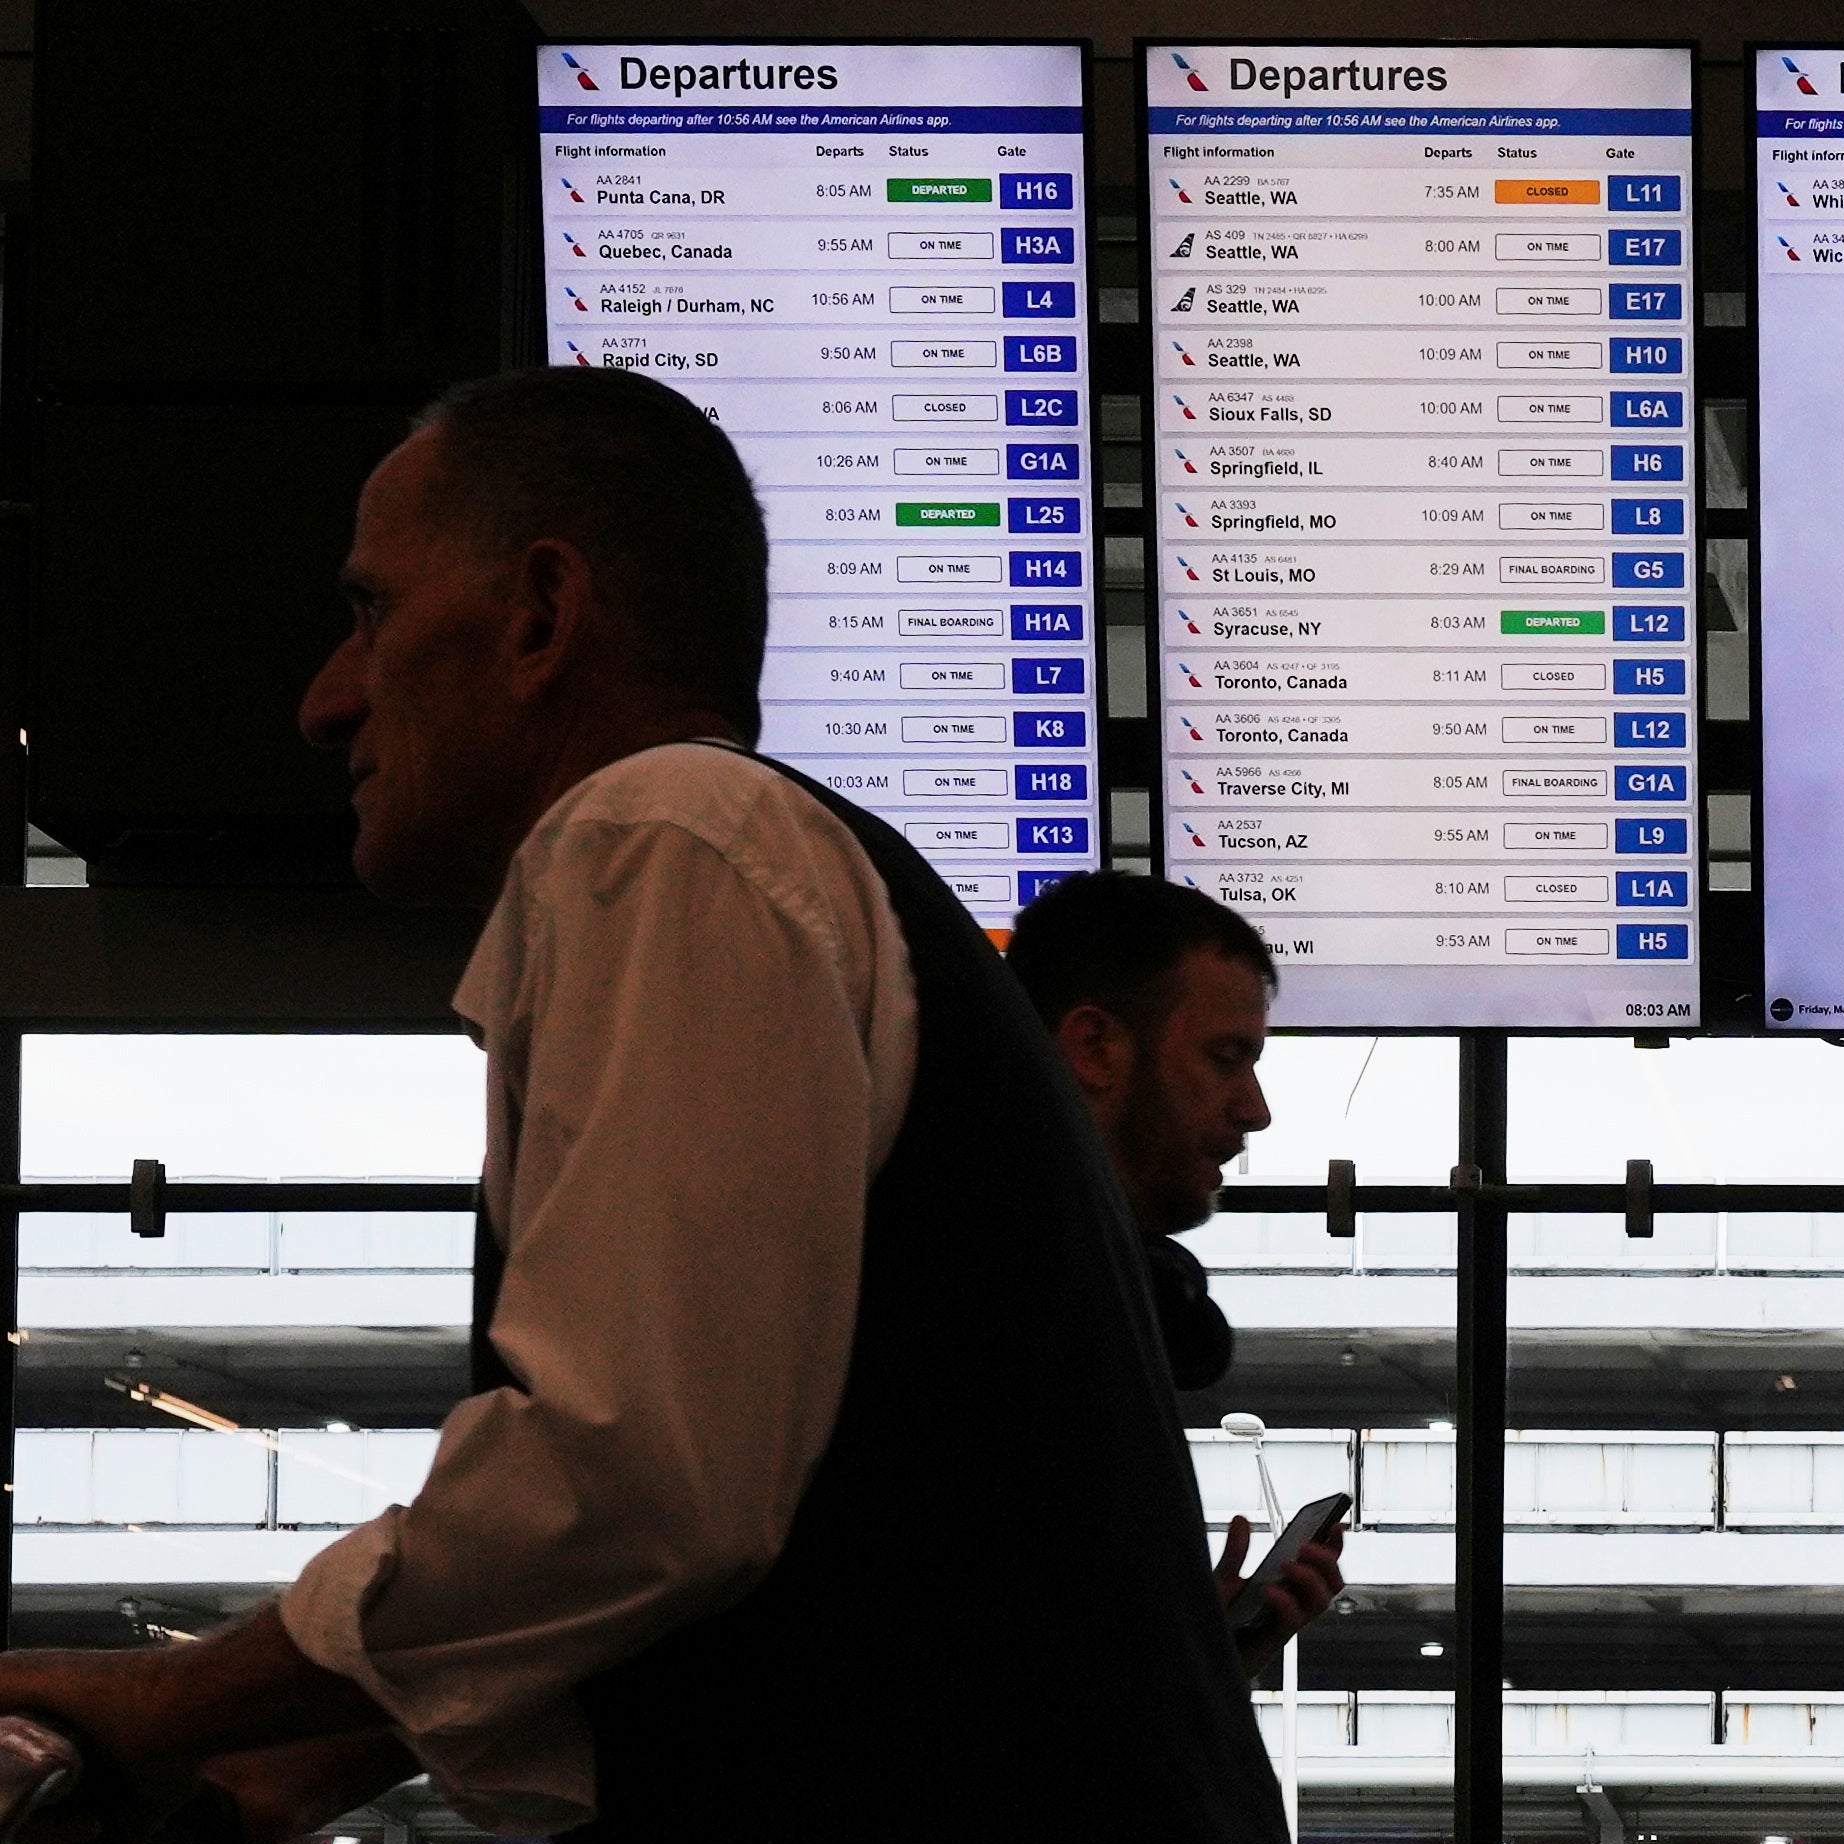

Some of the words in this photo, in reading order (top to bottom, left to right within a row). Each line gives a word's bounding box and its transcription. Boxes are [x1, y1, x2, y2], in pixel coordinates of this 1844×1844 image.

[621, 57, 837, 97] Departures
[1231, 59, 1447, 99] Departures
[567, 114, 587, 124] For
[591, 114, 625, 127] flights
[628, 114, 683, 127] departing
[687, 114, 714, 125] after
[718, 114, 749, 125] 10:56
[752, 114, 772, 124] AM
[776, 117, 797, 125] see
[801, 114, 819, 125] the
[821, 114, 877, 125] American
[880, 114, 923, 125] Airlines
[927, 117, 951, 127] app.
[556, 146, 591, 159] Flight
[595, 146, 665, 156] information
[817, 146, 864, 158] Departs
[889, 146, 928, 156] Status
[998, 146, 1026, 156] Gate
[597, 176, 612, 184] AA
[616, 175, 640, 185] 2841
[1204, 176, 1220, 185] AA
[1224, 176, 1250, 185] 2299
[598, 191, 644, 204] Punta
[650, 190, 695, 206] Cana,
[701, 190, 725, 204] DR
[817, 185, 845, 197] 8:05
[850, 185, 871, 196] AM
[912, 185, 967, 194] DEPARTED
[1017, 182, 1057, 200] H16
[1426, 186, 1453, 198] 7:35
[1457, 186, 1478, 198] AM
[1527, 187, 1568, 196] CLOSED
[1627, 184, 1660, 202] L11
[1205, 191, 1264, 207] Seattle,
[1271, 191, 1297, 204] WA
[1205, 230, 1221, 240] AS
[1225, 231, 1245, 240] 409
[600, 245, 665, 260] Quebec,
[672, 245, 732, 258] Canada
[1016, 236, 1061, 254] H3A
[1626, 238, 1665, 256] E17
[813, 293, 848, 305] 10:56
[852, 293, 874, 304] AM
[1027, 291, 1052, 308] L4
[603, 353, 649, 369] Rapid
[655, 353, 689, 370] City,
[696, 353, 718, 366] SD
[1020, 345, 1061, 362] L6B
[1627, 346, 1666, 364] H10
[925, 403, 966, 412] CLOSED
[1022, 399, 1062, 416] L2C
[1210, 408, 1255, 421] Sioux
[1261, 408, 1302, 423] Falls,
[1309, 408, 1331, 421] SD
[1627, 400, 1668, 418] L6A
[1021, 453, 1067, 470] G1A
[1211, 461, 1302, 478] Springfield,
[1309, 462, 1323, 474] IL
[1634, 454, 1661, 471] H6
[1027, 506, 1064, 524] L25
[1636, 507, 1661, 525] L8
[1026, 560, 1067, 577] H14
[1213, 569, 1229, 582] St
[1235, 569, 1283, 584] Louis,
[1290, 569, 1315, 582] MO
[1542, 566, 1595, 574] BOARDING
[1634, 561, 1663, 578] G5
[908, 618, 937, 626] FINAL
[940, 618, 993, 626] BOARDING
[1026, 613, 1070, 631] H1A
[1214, 622, 1292, 639] Syracuse,
[1299, 622, 1321, 635] NY
[1431, 617, 1460, 628] 8:03
[1464, 617, 1485, 628] AM
[1526, 617, 1579, 627] DEPARTED
[1631, 615, 1668, 632] L12
[1037, 667, 1061, 684] L7
[1215, 676, 1281, 691] Toronto,
[1287, 676, 1347, 688] Canada
[1637, 668, 1664, 685] H5
[1037, 720, 1064, 737] K8
[1032, 773, 1071, 790] H18
[1218, 782, 1285, 795] Traverse
[1292, 782, 1325, 798] City,
[1332, 782, 1348, 795] MI
[1629, 774, 1674, 791] G1A
[1033, 826, 1073, 843] K13
[1219, 835, 1280, 850] Tucson,
[1286, 835, 1307, 848] AZ
[1640, 827, 1664, 844] L9
[1220, 888, 1266, 904] Tulsa,
[1272, 888, 1296, 901] OK
[1632, 880, 1673, 897] L1A
[1626, 1004, 1663, 1016] 08:03
[1667, 1004, 1690, 1016] AM
[1799, 1005, 1831, 1015] Friday,
